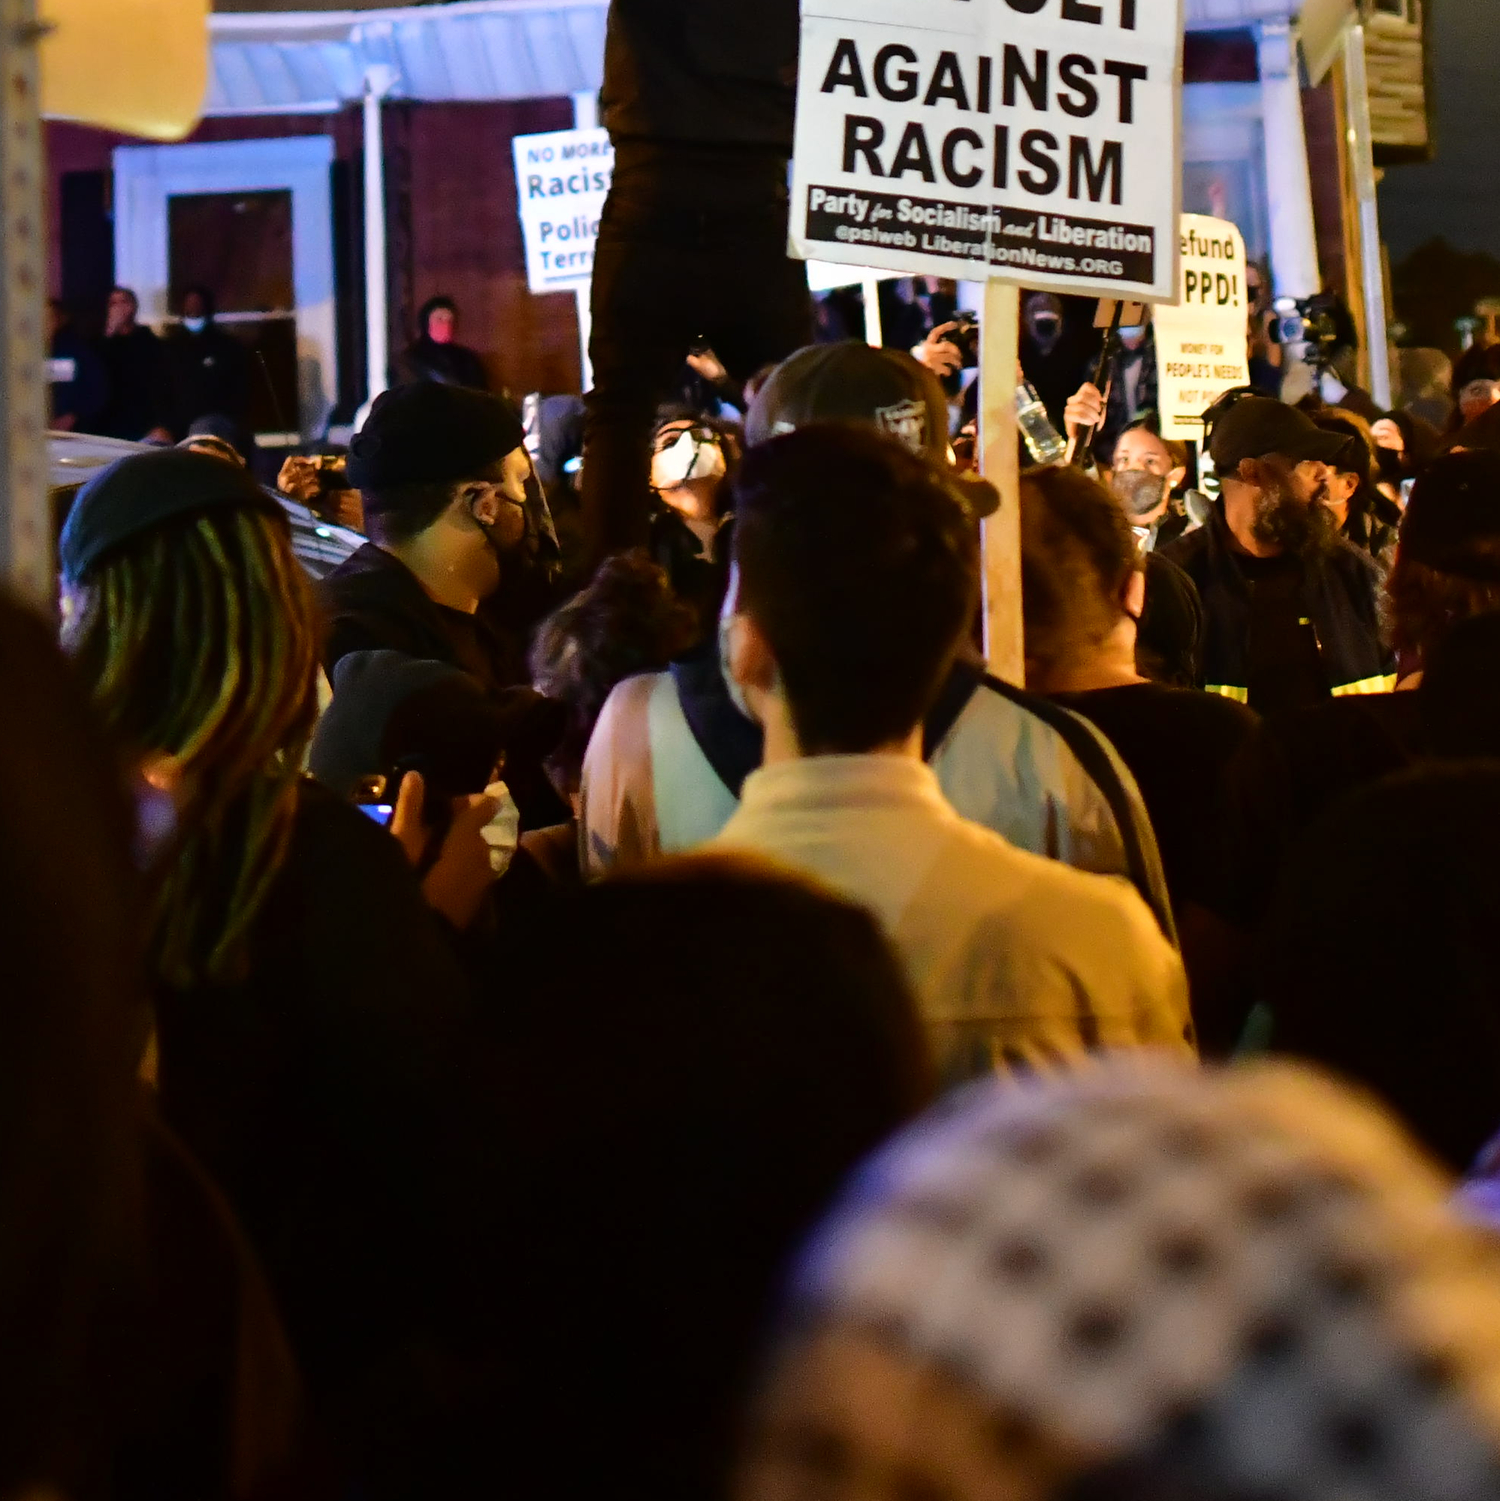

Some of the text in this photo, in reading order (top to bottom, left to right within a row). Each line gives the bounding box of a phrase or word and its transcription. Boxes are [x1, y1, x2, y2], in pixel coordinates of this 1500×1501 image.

[820, 38, 1147, 124] AGAINST
[527, 147, 554, 163] NO
[842, 114, 1122, 205] RACISM
[528, 166, 611, 199] Racis
[540, 215, 599, 243] Polic
[810, 188, 1152, 253] Party for Socialism and Liberation
[540, 250, 594, 270] Terr
[921, 233, 1124, 275] LiberationNews.ORG
[1180, 229, 1235, 260] efund
[1185, 269, 1238, 307] PPD!
[1166, 362, 1243, 380] PEOPLE'S NEEDS
